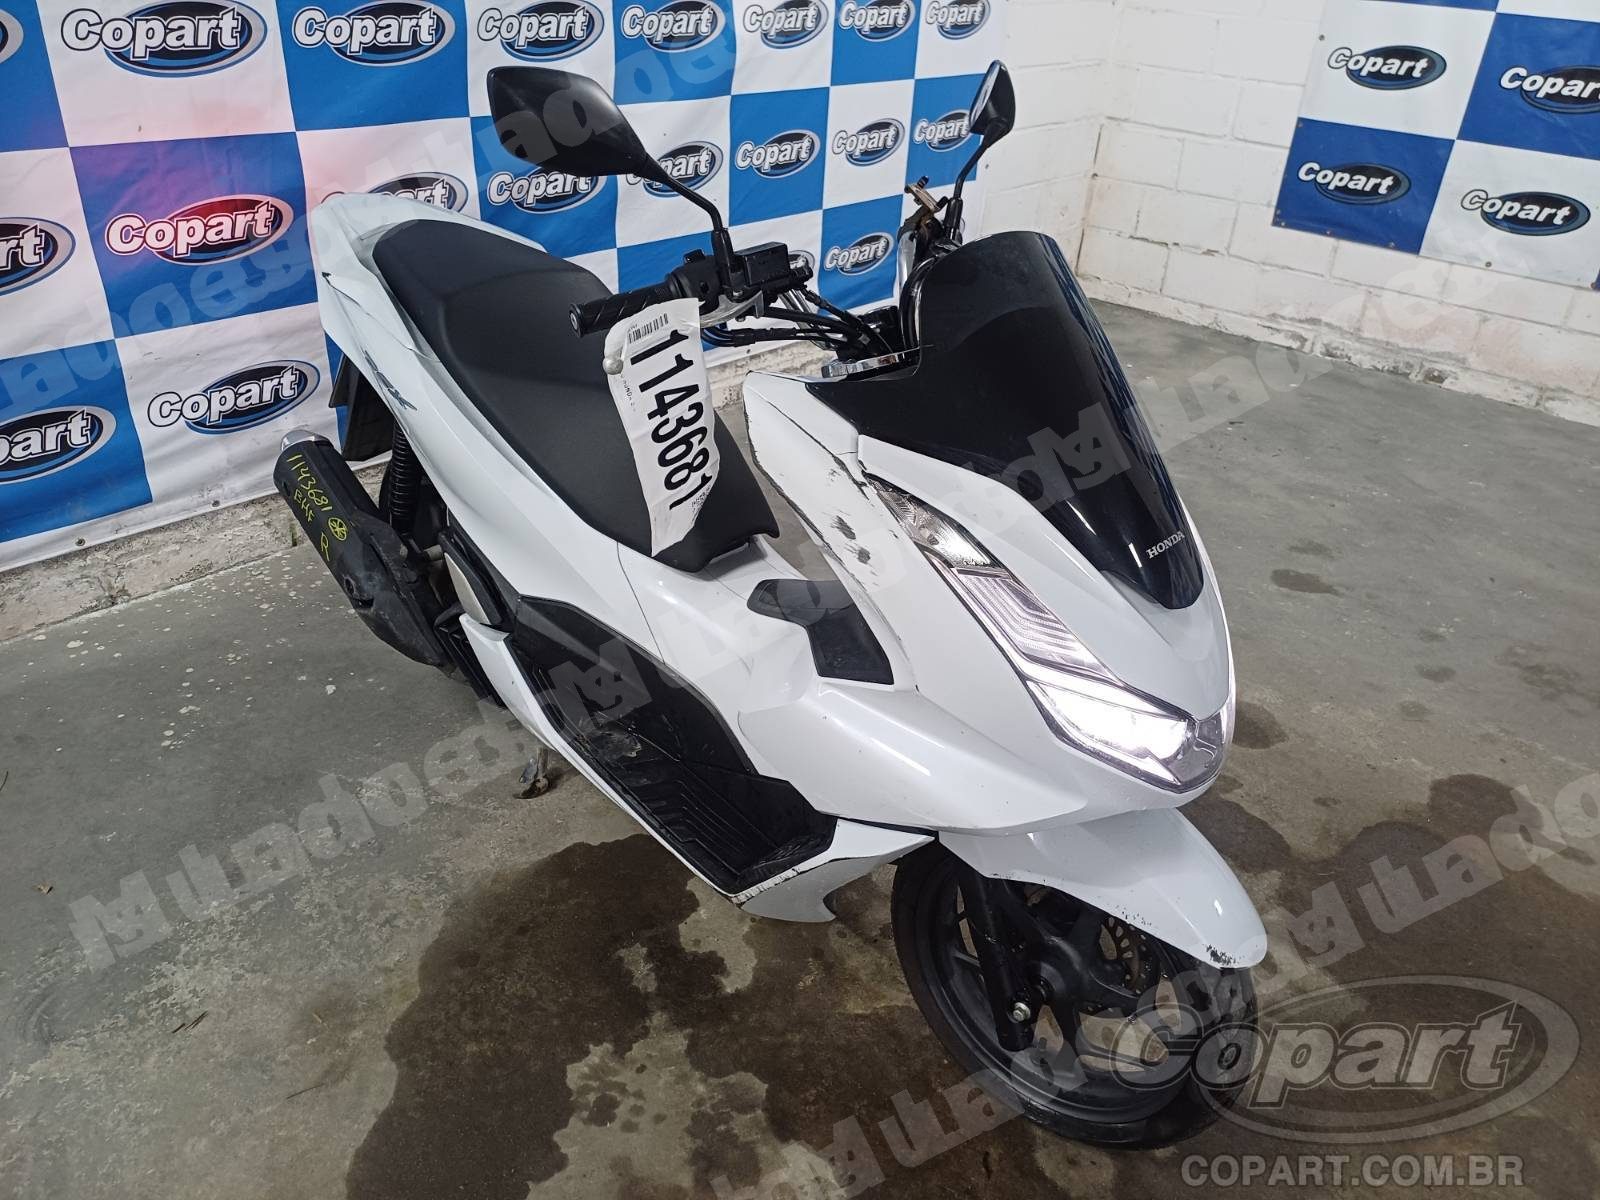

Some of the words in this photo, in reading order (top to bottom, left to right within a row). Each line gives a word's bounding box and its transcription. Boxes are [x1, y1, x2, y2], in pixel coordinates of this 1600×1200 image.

[61, 5, 241, 61] Copart
[293, 4, 437, 55] Copart
[478, 5, 590, 49] Copart
[622, 3, 713, 44] Copart
[743, 2, 818, 39] Copart
[839, 1, 908, 34] Copart
[925, 0, 983, 31] Copart
[1328, 46, 1430, 78] Copart
[1500, 66, 1600, 99] Copar
[736, 133, 813, 172] Copart
[833, 124, 897, 156] Copart
[1297, 162, 1394, 195] Copart
[1460, 188, 1571, 226] Copart
[105, 201, 274, 256] Copart
[824, 237, 889, 271] Copart
[147, 364, 301, 428] Copart
[630, 329, 713, 510] 1143681
[286, 454, 333, 512] 1143681
[1146, 530, 1185, 559] HONDA
